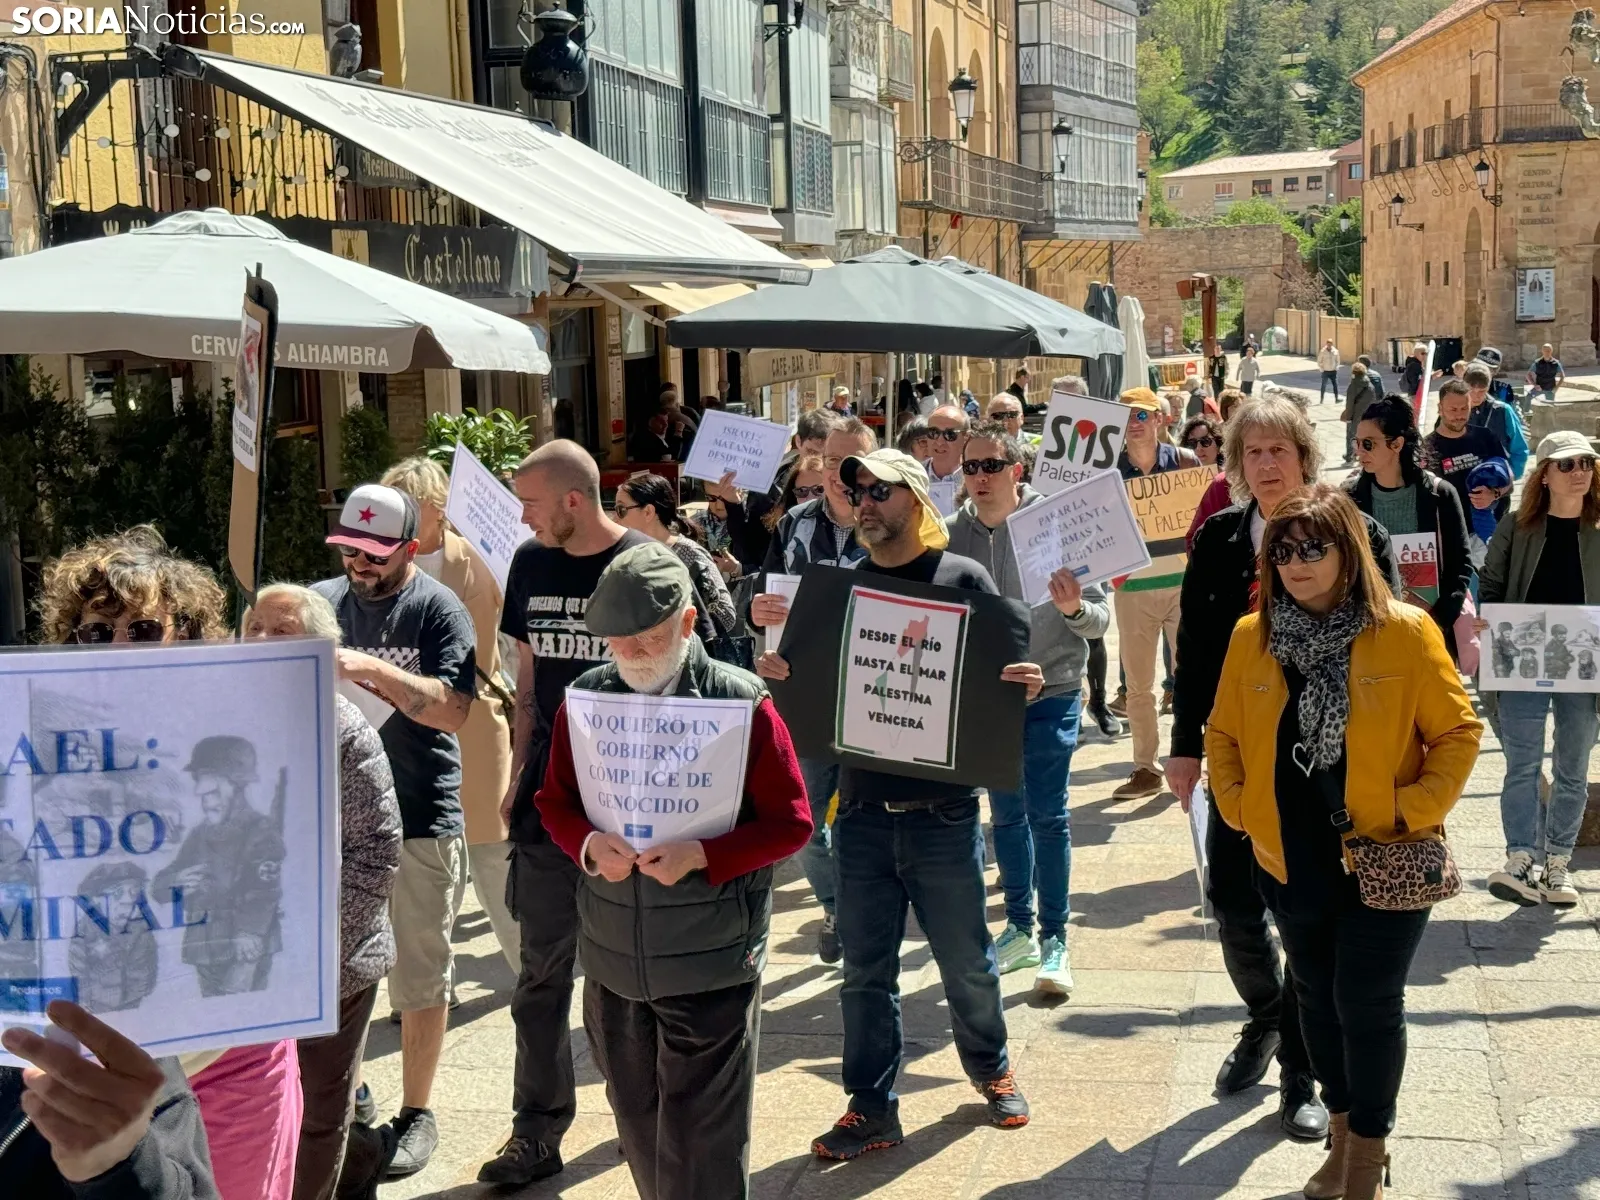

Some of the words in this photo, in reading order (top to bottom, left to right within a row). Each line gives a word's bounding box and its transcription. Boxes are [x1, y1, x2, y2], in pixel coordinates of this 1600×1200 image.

[1523, 169, 1551, 177] CENTRO
[404, 233, 501, 284] Castellano
[191, 334, 281, 361] CERVS
[287, 342, 390, 367] ALHAMBRA
[707, 449, 739, 464] DESDE
[742, 458, 761, 469] 1948
[713, 438, 763, 457] MATANDO
[1039, 461, 1093, 484] Palesti
[1174, 467, 1215, 490] APOYA
[1039, 504, 1071, 526] PARAR
[1073, 498, 1088, 510] LA
[1028, 505, 1110, 548] COMPRA-VENTA
[1056, 527, 1092, 549] ARMAS
[1095, 524, 1104, 533] A
[1402, 543, 1411, 551] A
[1418, 541, 1435, 551] LA
[565, 597, 581, 615] QUE
[859, 628, 897, 645] DESDE
[901, 635, 916, 649] EL
[920, 636, 942, 652] RÍO
[854, 655, 895, 672] HASTA
[899, 663, 914, 675] EL
[919, 666, 947, 681] MAR
[863, 683, 932, 706] PALESTINA
[582, 712, 603, 730] NO
[607, 715, 685, 735] QUIERO
[692, 719, 721, 736] UN
[867, 710, 924, 730] VENCERÁ
[596, 740, 699, 762] GOBIERNO
[589, 762, 680, 787] CÓMPLICE
[686, 772, 713, 788] DE
[598, 791, 699, 814] GENOCIDIO
